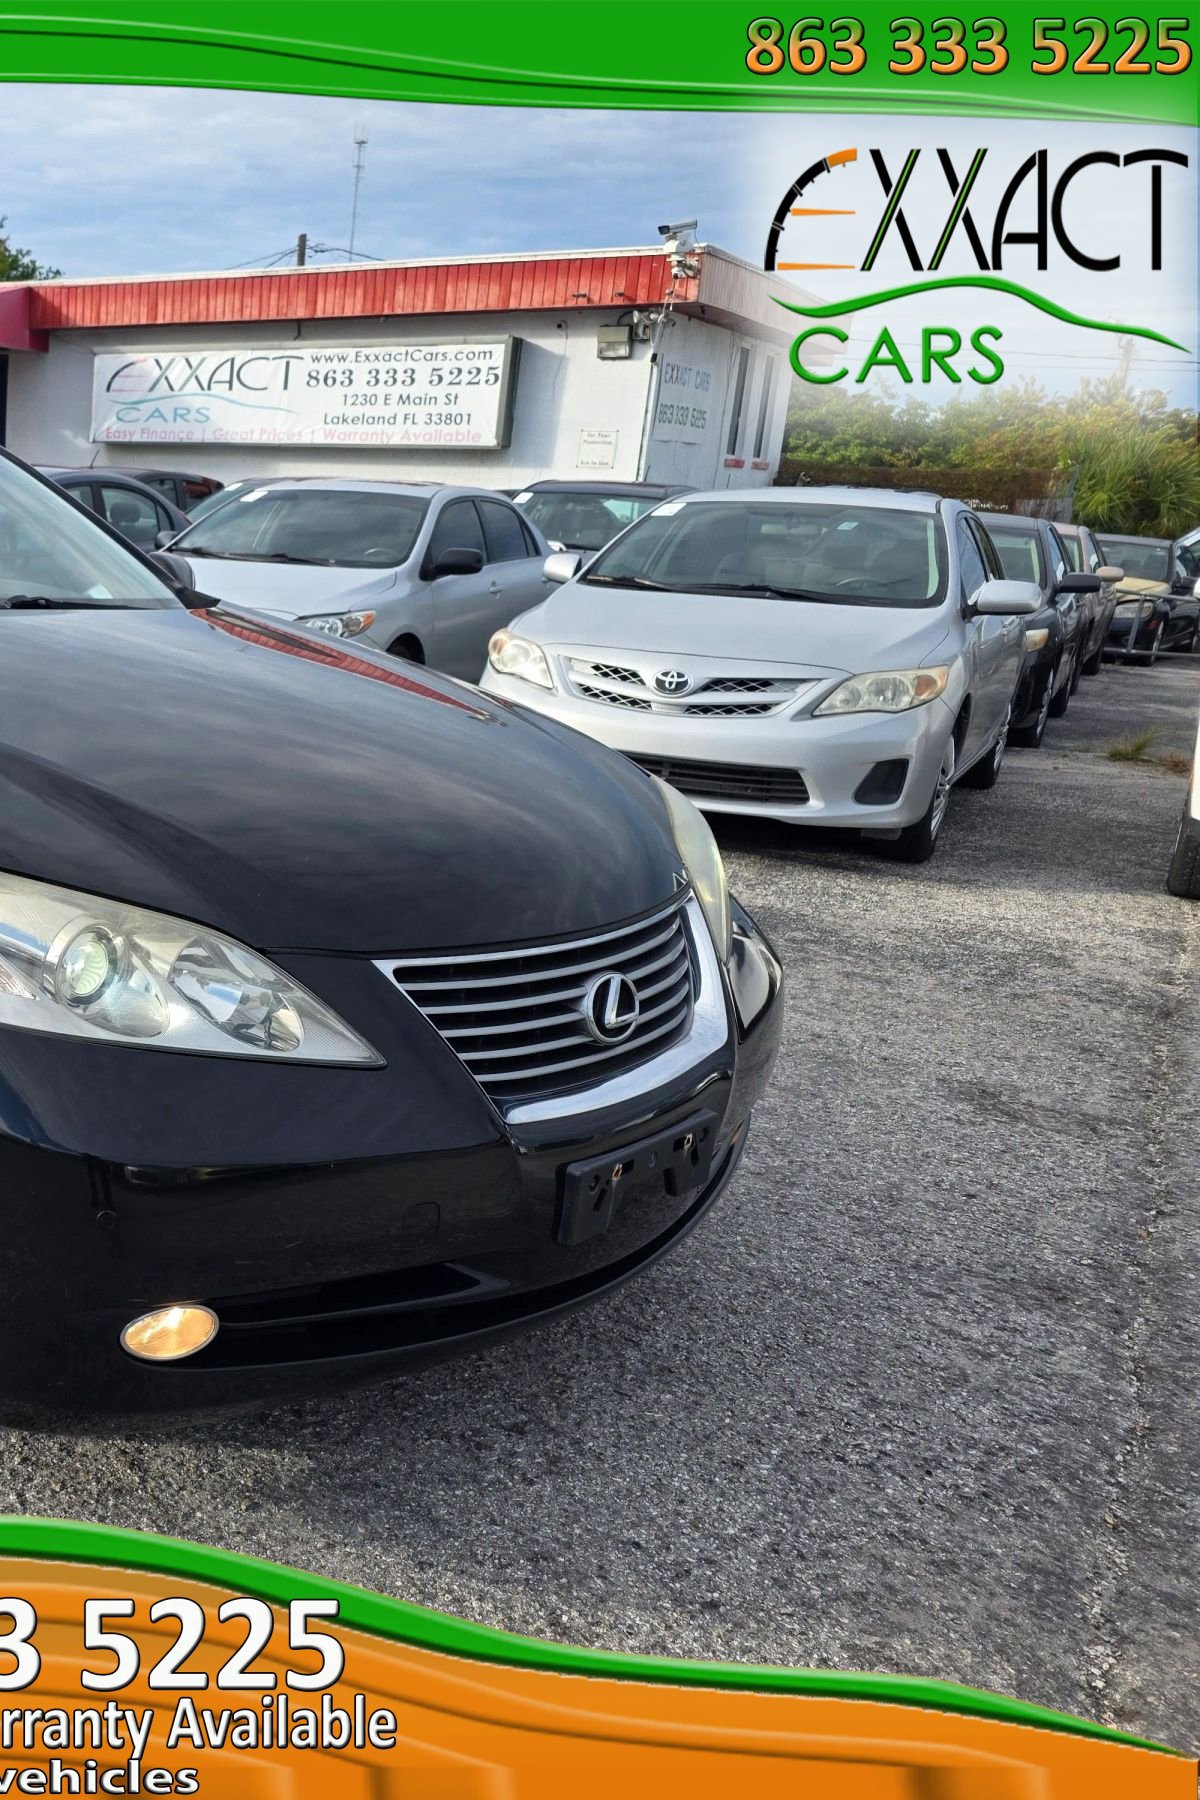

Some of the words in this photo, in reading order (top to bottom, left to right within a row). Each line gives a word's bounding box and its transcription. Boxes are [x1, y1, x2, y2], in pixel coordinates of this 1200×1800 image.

[311, 349, 493, 363] www.ExxactCars.com
[106, 355, 304, 393] EXXACT
[306, 369, 354, 388] 863
[366, 368, 416, 387] 333
[428, 366, 500, 387] 5225
[343, 394, 378, 406] 1230
[383, 394, 392, 406] E
[397, 393, 439, 406] Main
[444, 392, 459, 406] St
[116, 407, 210, 423] CARS
[324, 413, 397, 426] Lakeland
[403, 413, 418, 426] FL
[424, 413, 472, 426] 33801
[106, 428, 135, 441] Easy
[140, 428, 195, 441] Finance
[213, 428, 253, 441] Great
[259, 428, 303, 442] Prices
[323, 429, 395, 444] Warranty
[400, 429, 482, 443] Available
